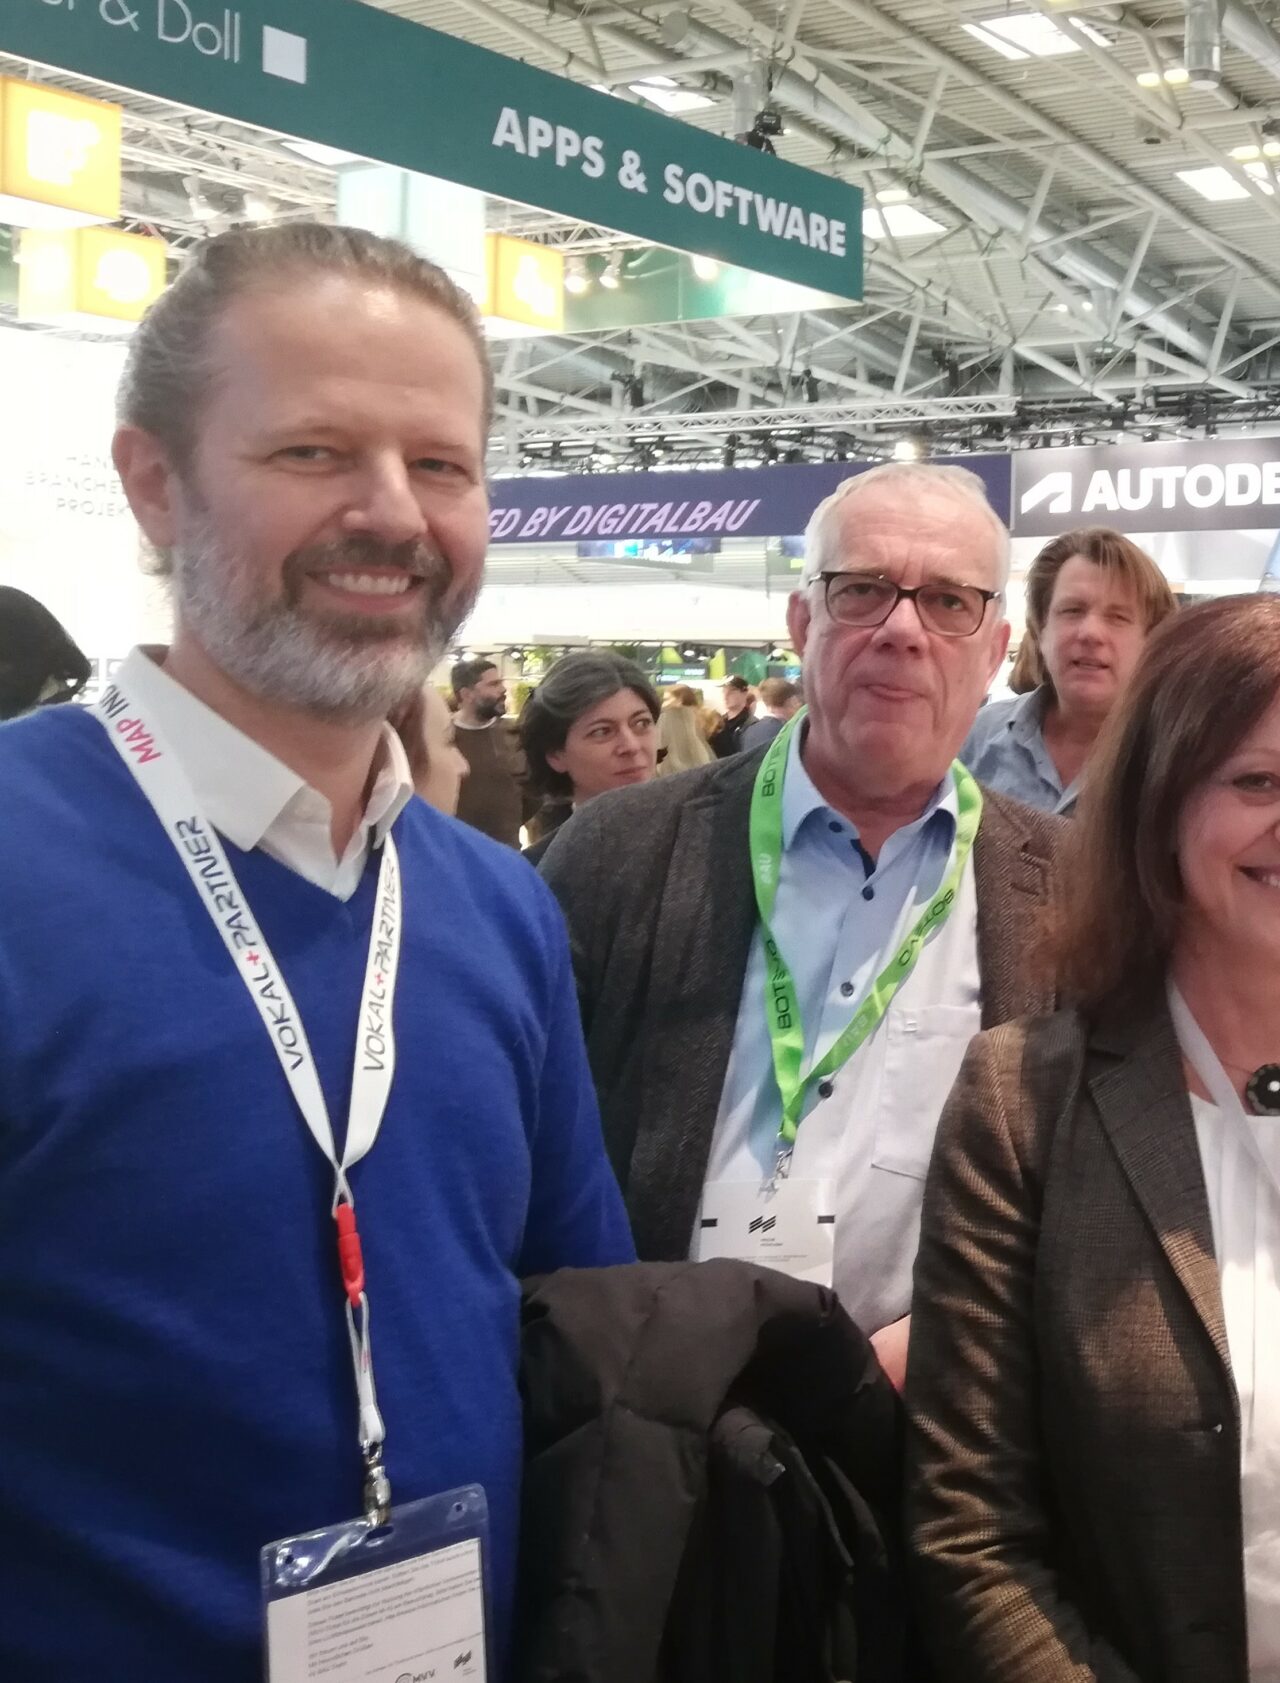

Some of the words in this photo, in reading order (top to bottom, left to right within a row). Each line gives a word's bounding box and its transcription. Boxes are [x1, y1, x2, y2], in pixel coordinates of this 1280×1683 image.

[157, 0, 241, 63] Doll
[491, 106, 606, 178] APPS
[617, 149, 648, 193] &
[662, 163, 847, 258] SOFTWARE
[56, 497, 129, 517] PROJEK
[517, 504, 572, 538] BY
[561, 498, 762, 536] DIGITALBAU
[116, 718, 162, 764] MAP
